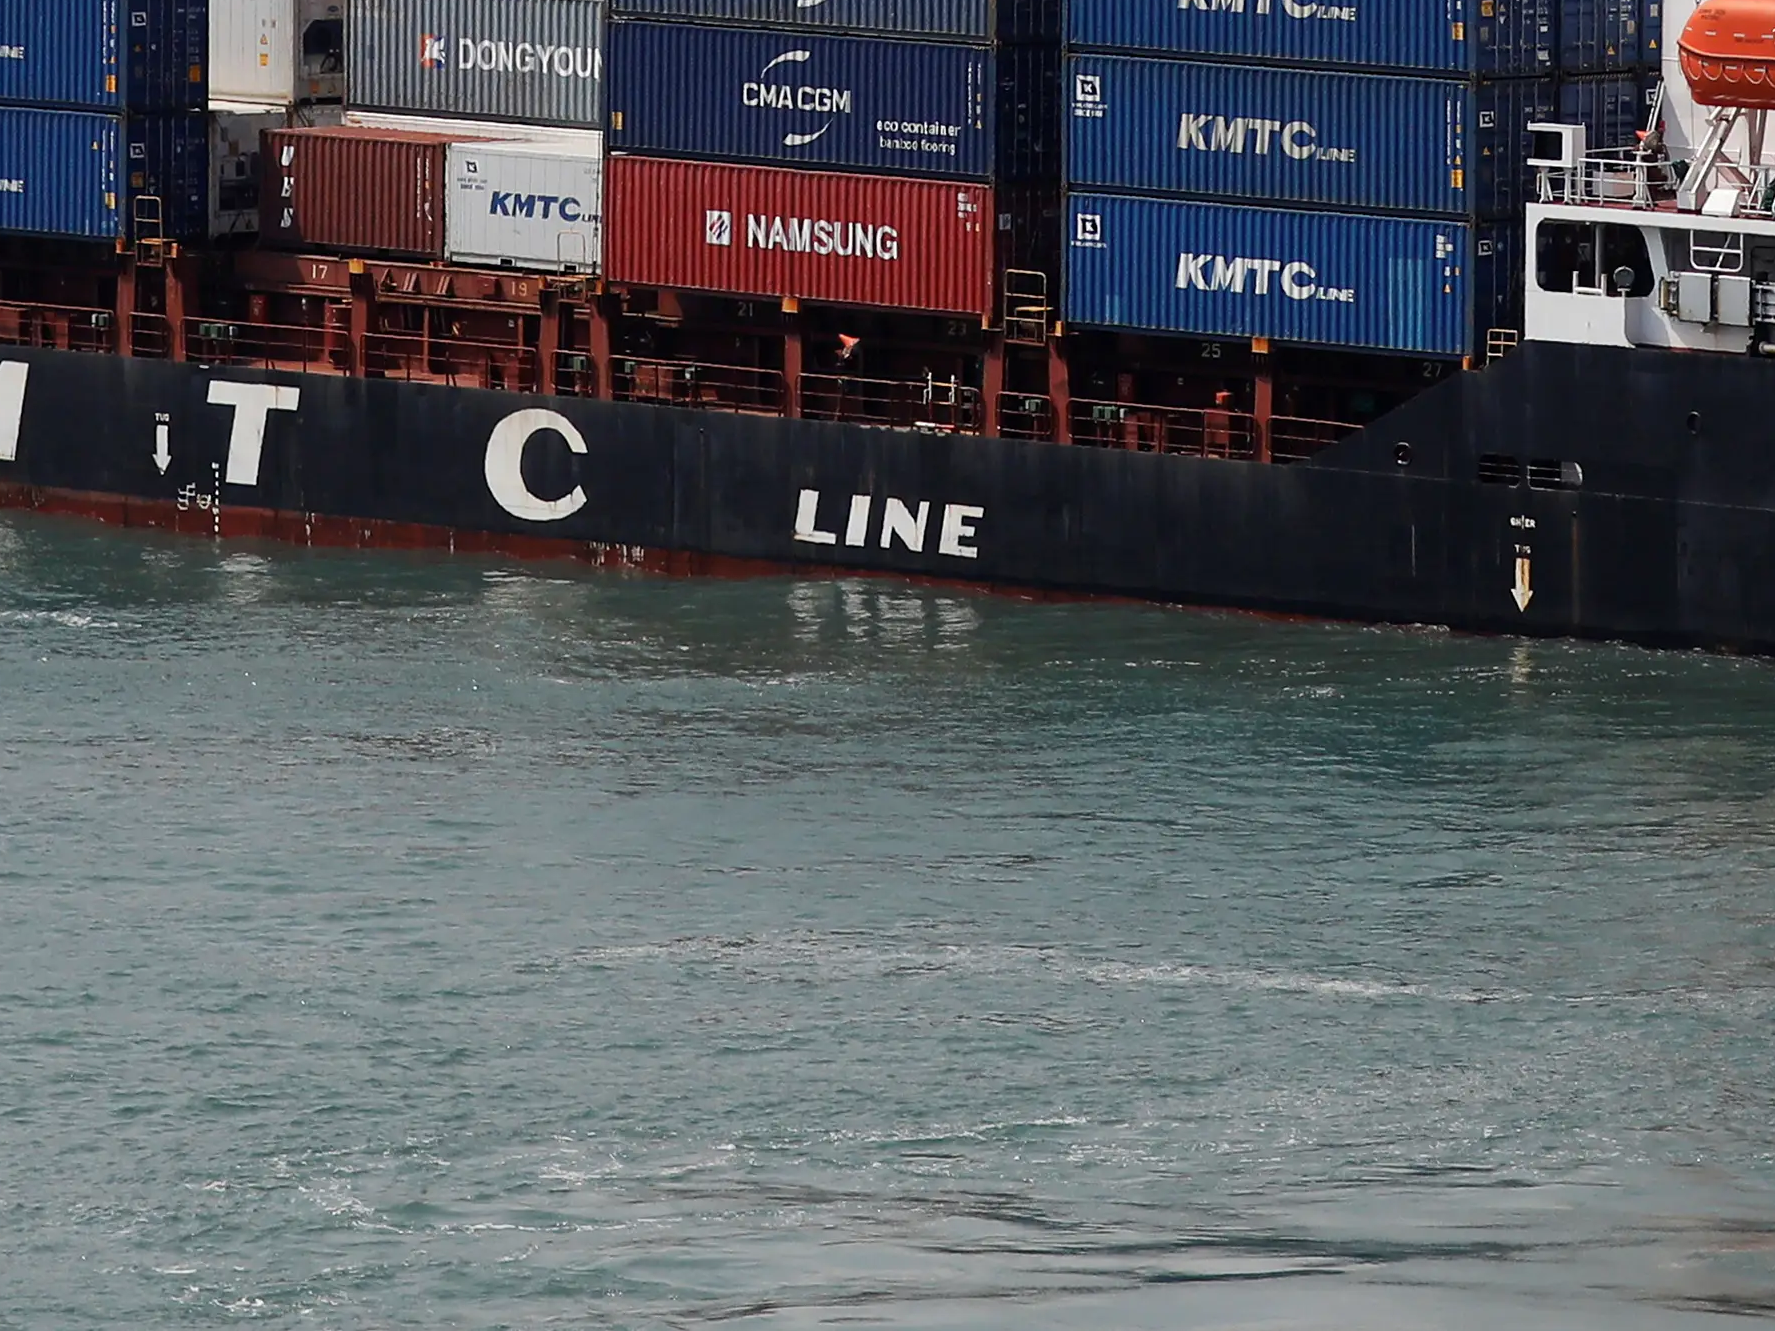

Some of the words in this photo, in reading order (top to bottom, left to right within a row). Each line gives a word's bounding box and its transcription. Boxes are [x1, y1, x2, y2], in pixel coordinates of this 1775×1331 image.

[1317, 4, 1356, 21] LINE
[743, 82, 793, 109] CMA
[797, 85, 852, 114] CGM
[877, 121, 898, 133] eco
[901, 121, 961, 137] container
[879, 135, 917, 151] bamboo
[920, 138, 955, 156] flooring
[1176, 113, 1316, 159] KMTC
[1316, 147, 1355, 162] LINE
[489, 190, 581, 222] KMTC
[747, 213, 897, 260] NAMSUNG
[312, 264, 328, 279] 17
[1175, 252, 1315, 300] KMTC
[1315, 286, 1354, 302] LINE
[511, 281, 527, 297] 19
[738, 302, 753, 317] 21
[948, 321, 966, 336] 23
[1202, 343, 1220, 358] 25
[1423, 362, 1441, 378] 27
[154, 412, 169, 422] TUG
[206, 379, 301, 486] T
[484, 407, 588, 522] C
[793, 488, 985, 559] LINE
